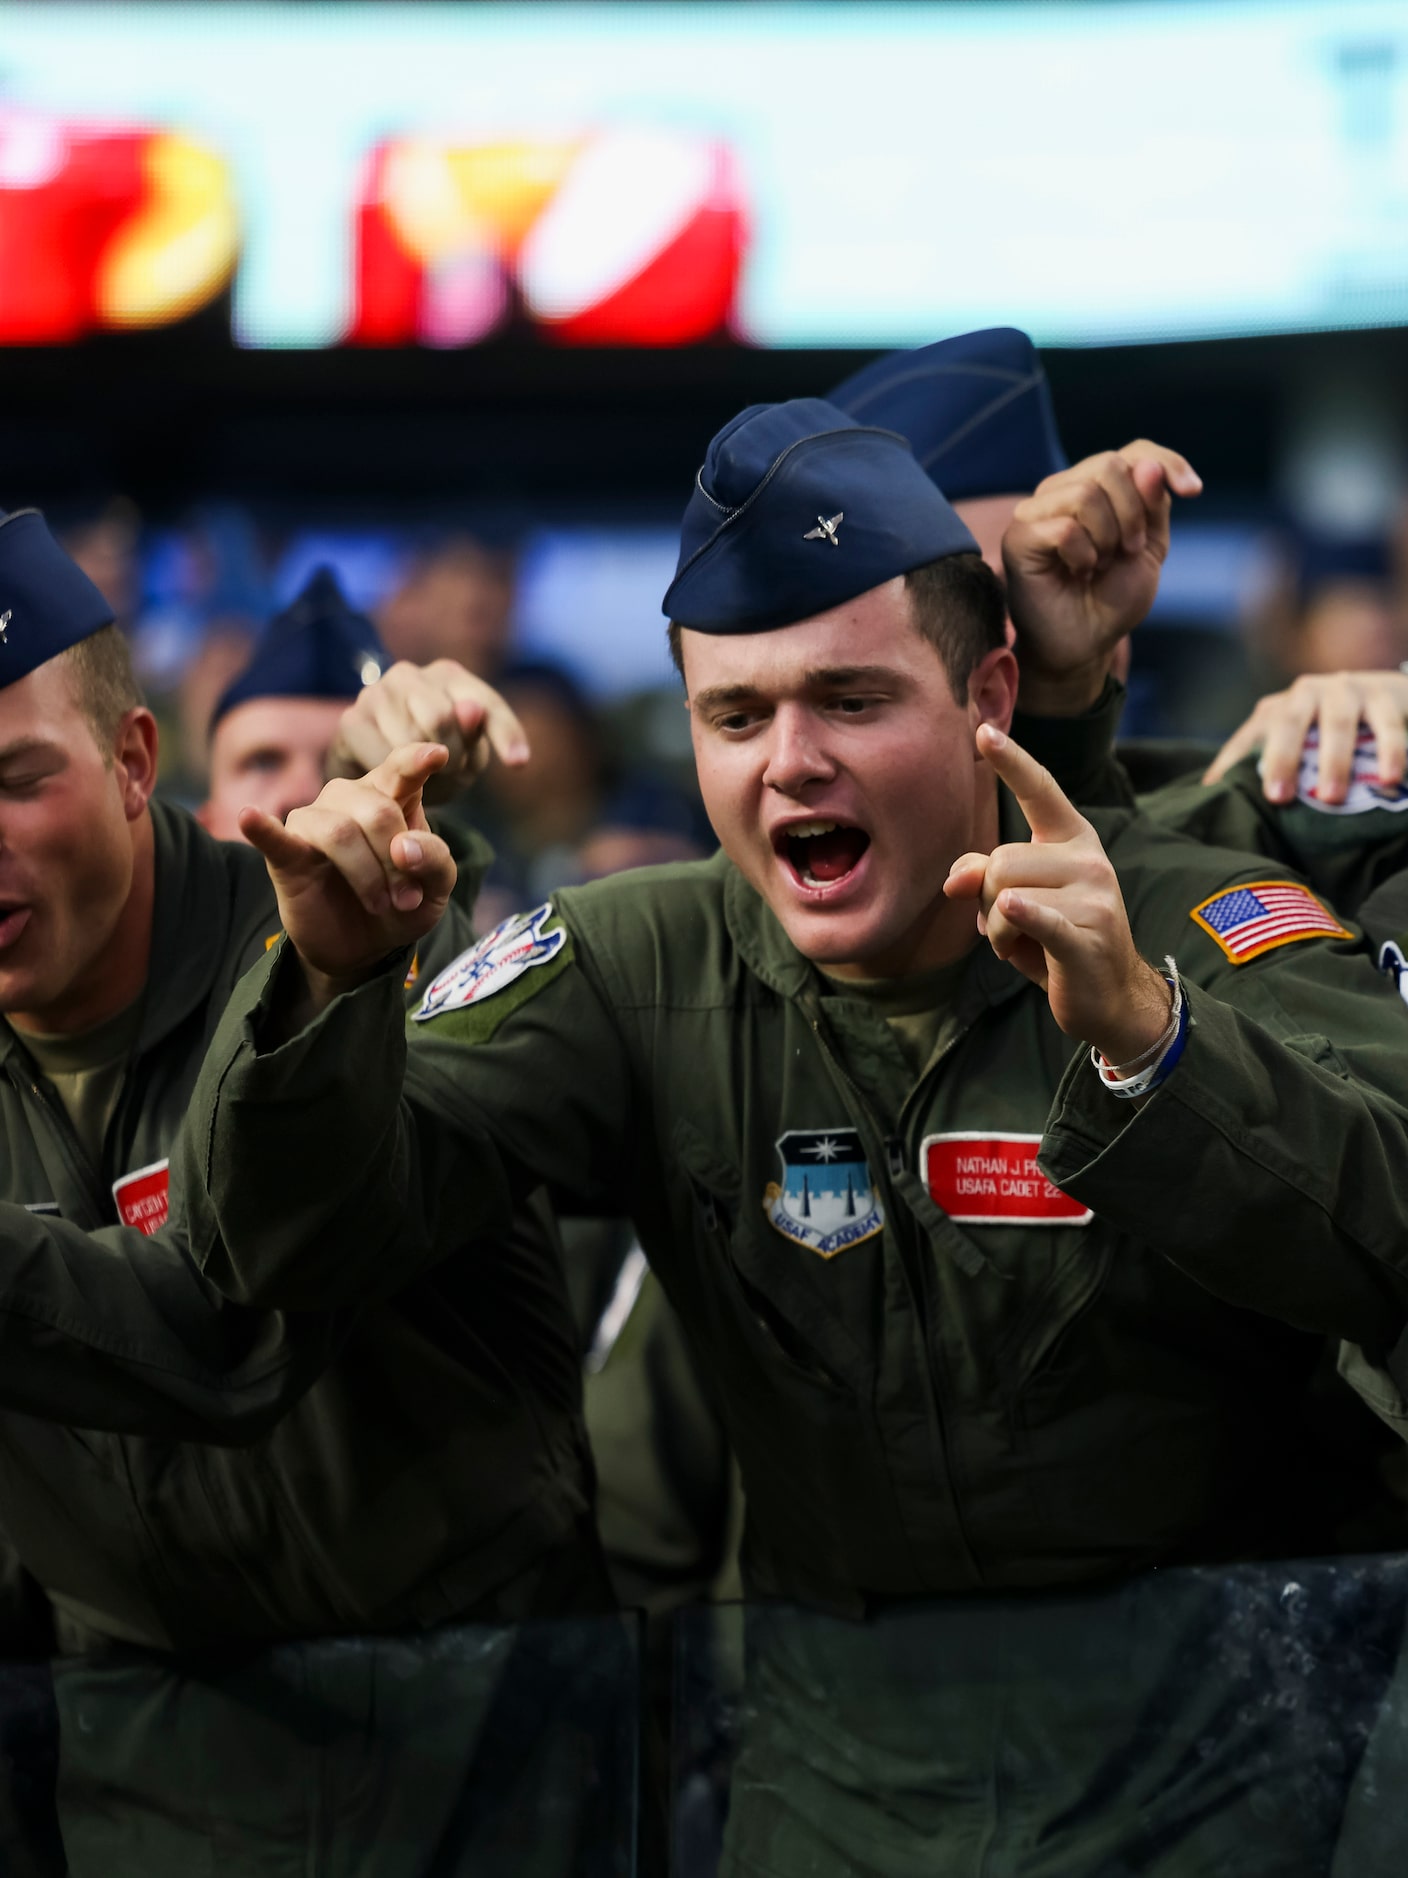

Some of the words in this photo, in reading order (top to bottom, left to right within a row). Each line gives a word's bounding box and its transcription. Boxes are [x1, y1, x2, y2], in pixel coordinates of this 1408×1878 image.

[956, 1157, 1007, 1175] NATHAN
[956, 1178, 997, 1195] USAFA
[1000, 1180, 1039, 1198] CADET
[775, 1213, 811, 1240] USAF
[817, 1211, 881, 1252] ACADEMY
